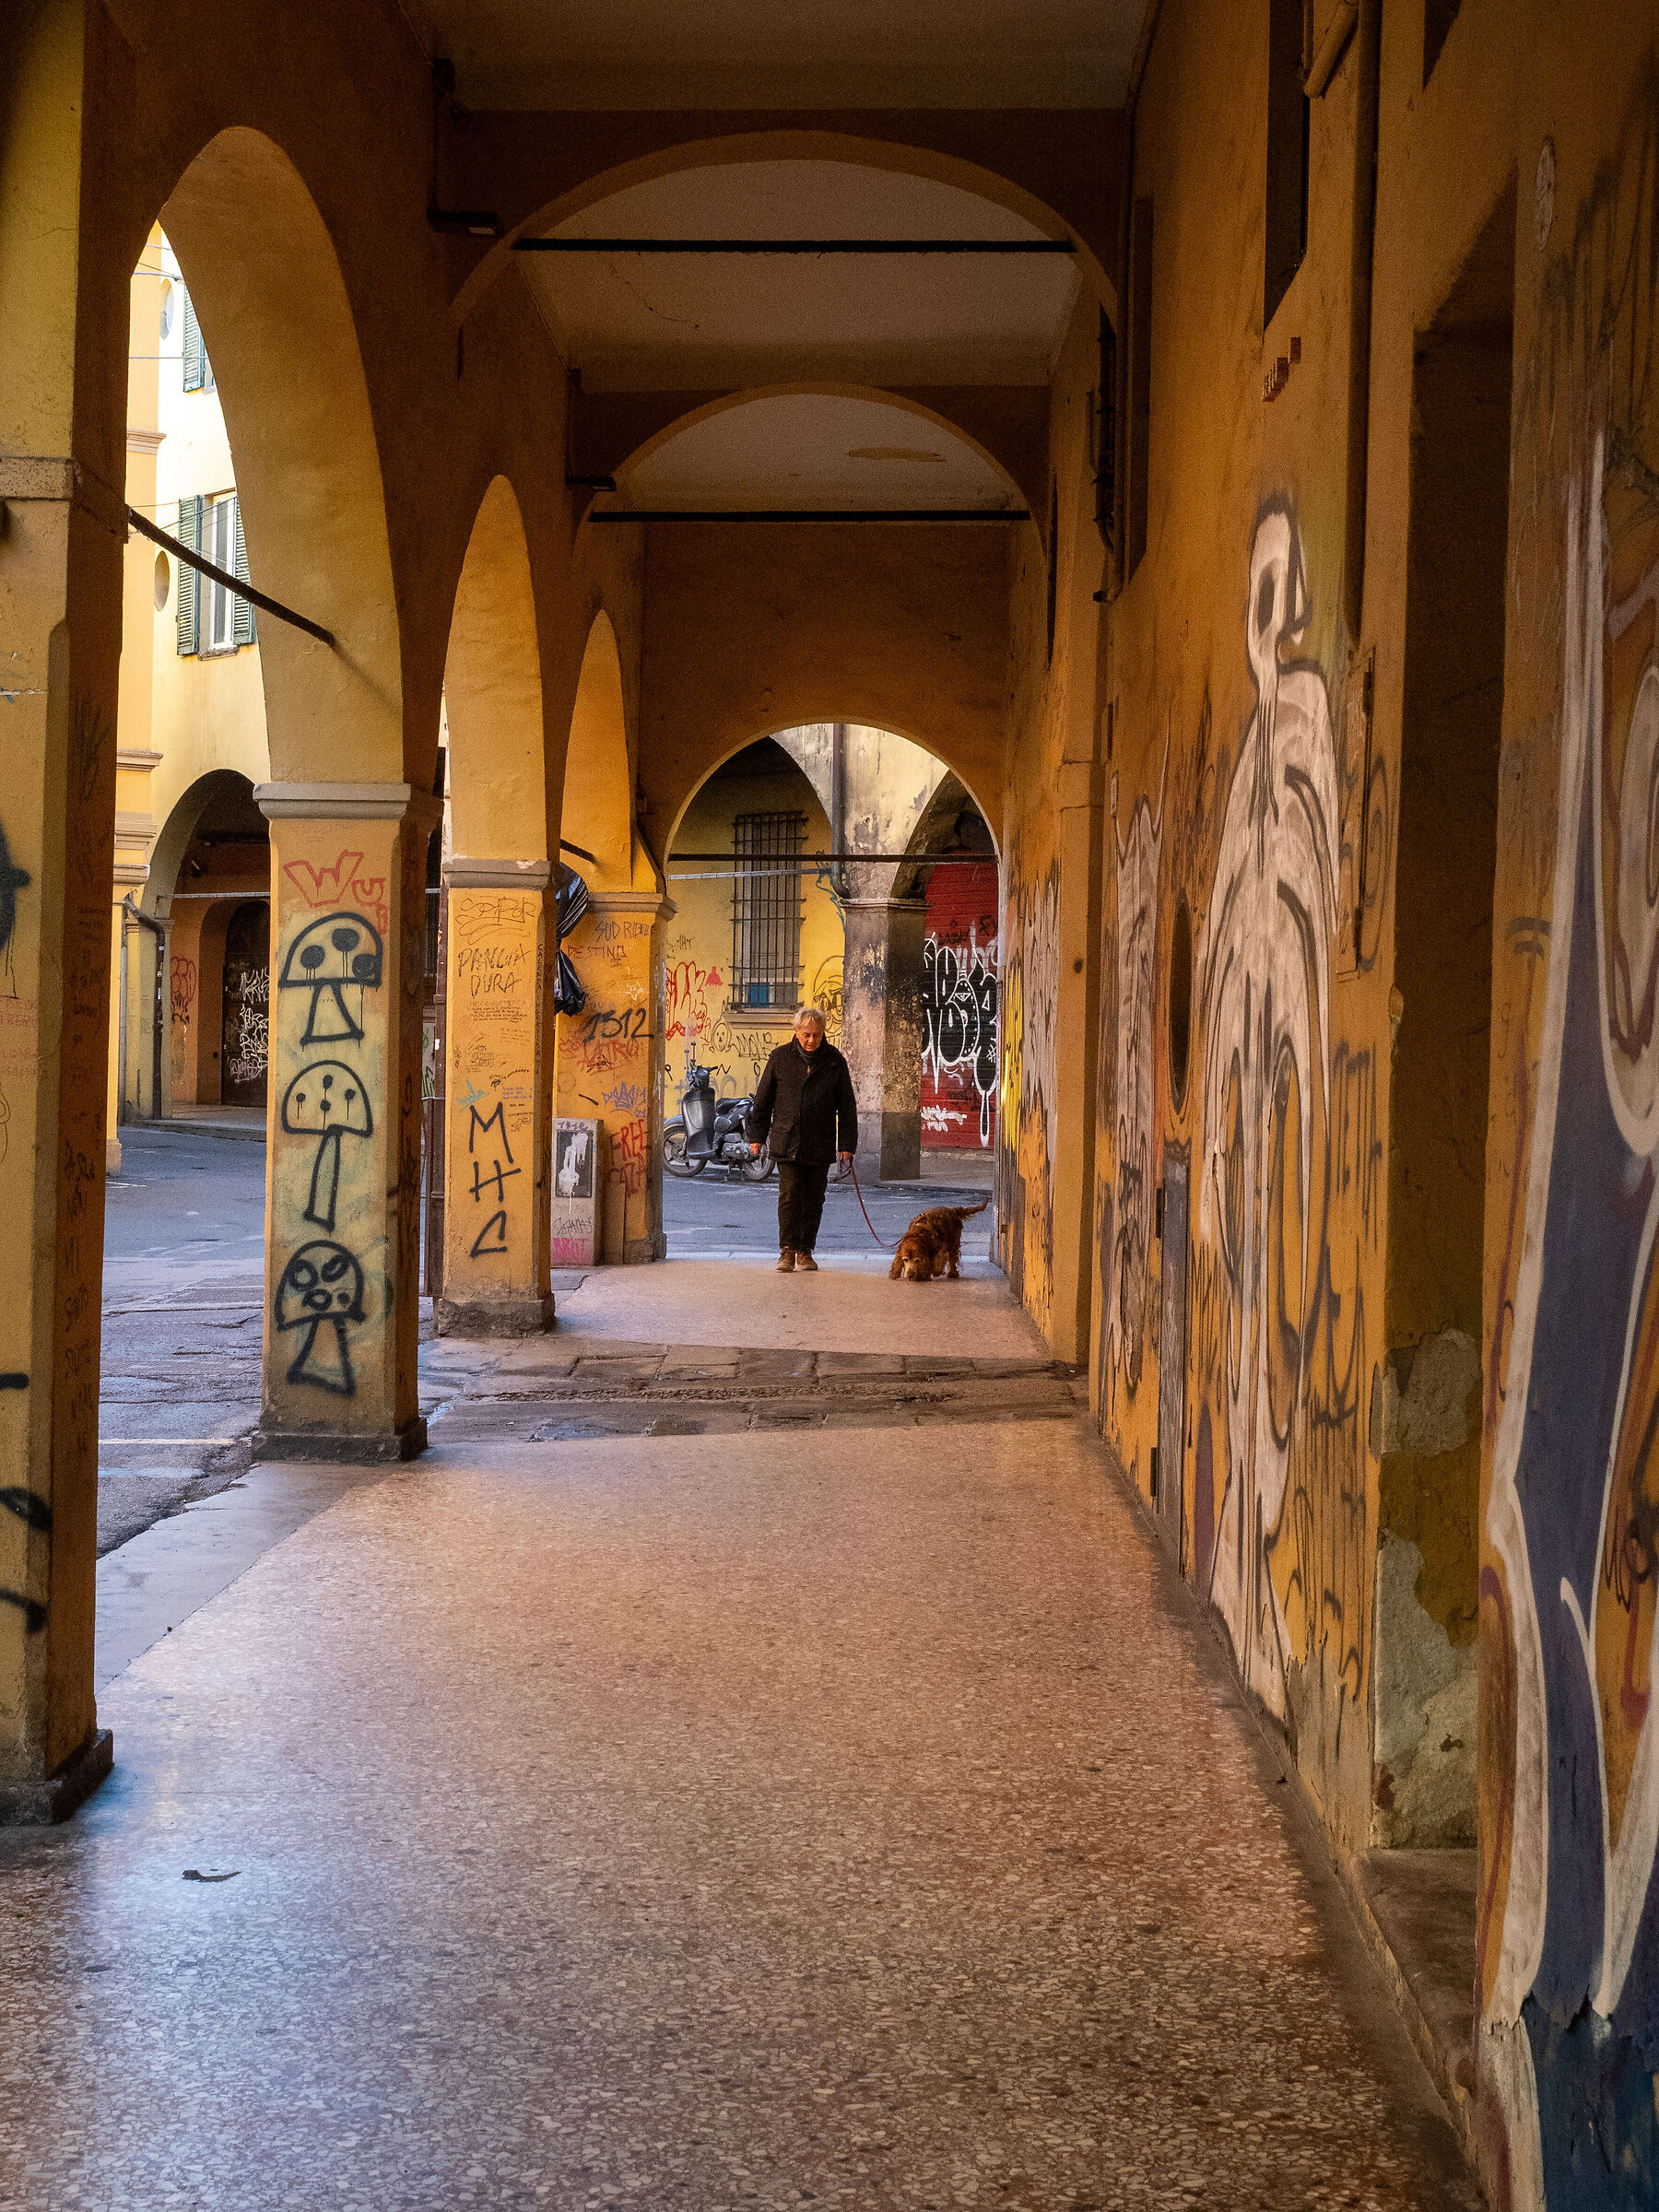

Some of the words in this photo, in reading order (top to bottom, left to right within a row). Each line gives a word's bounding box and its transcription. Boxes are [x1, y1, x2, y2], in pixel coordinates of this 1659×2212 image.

[594, 922, 621, 943] SUD
[470, 971, 523, 999] DURA
[606, 1119, 653, 1165] FREE
